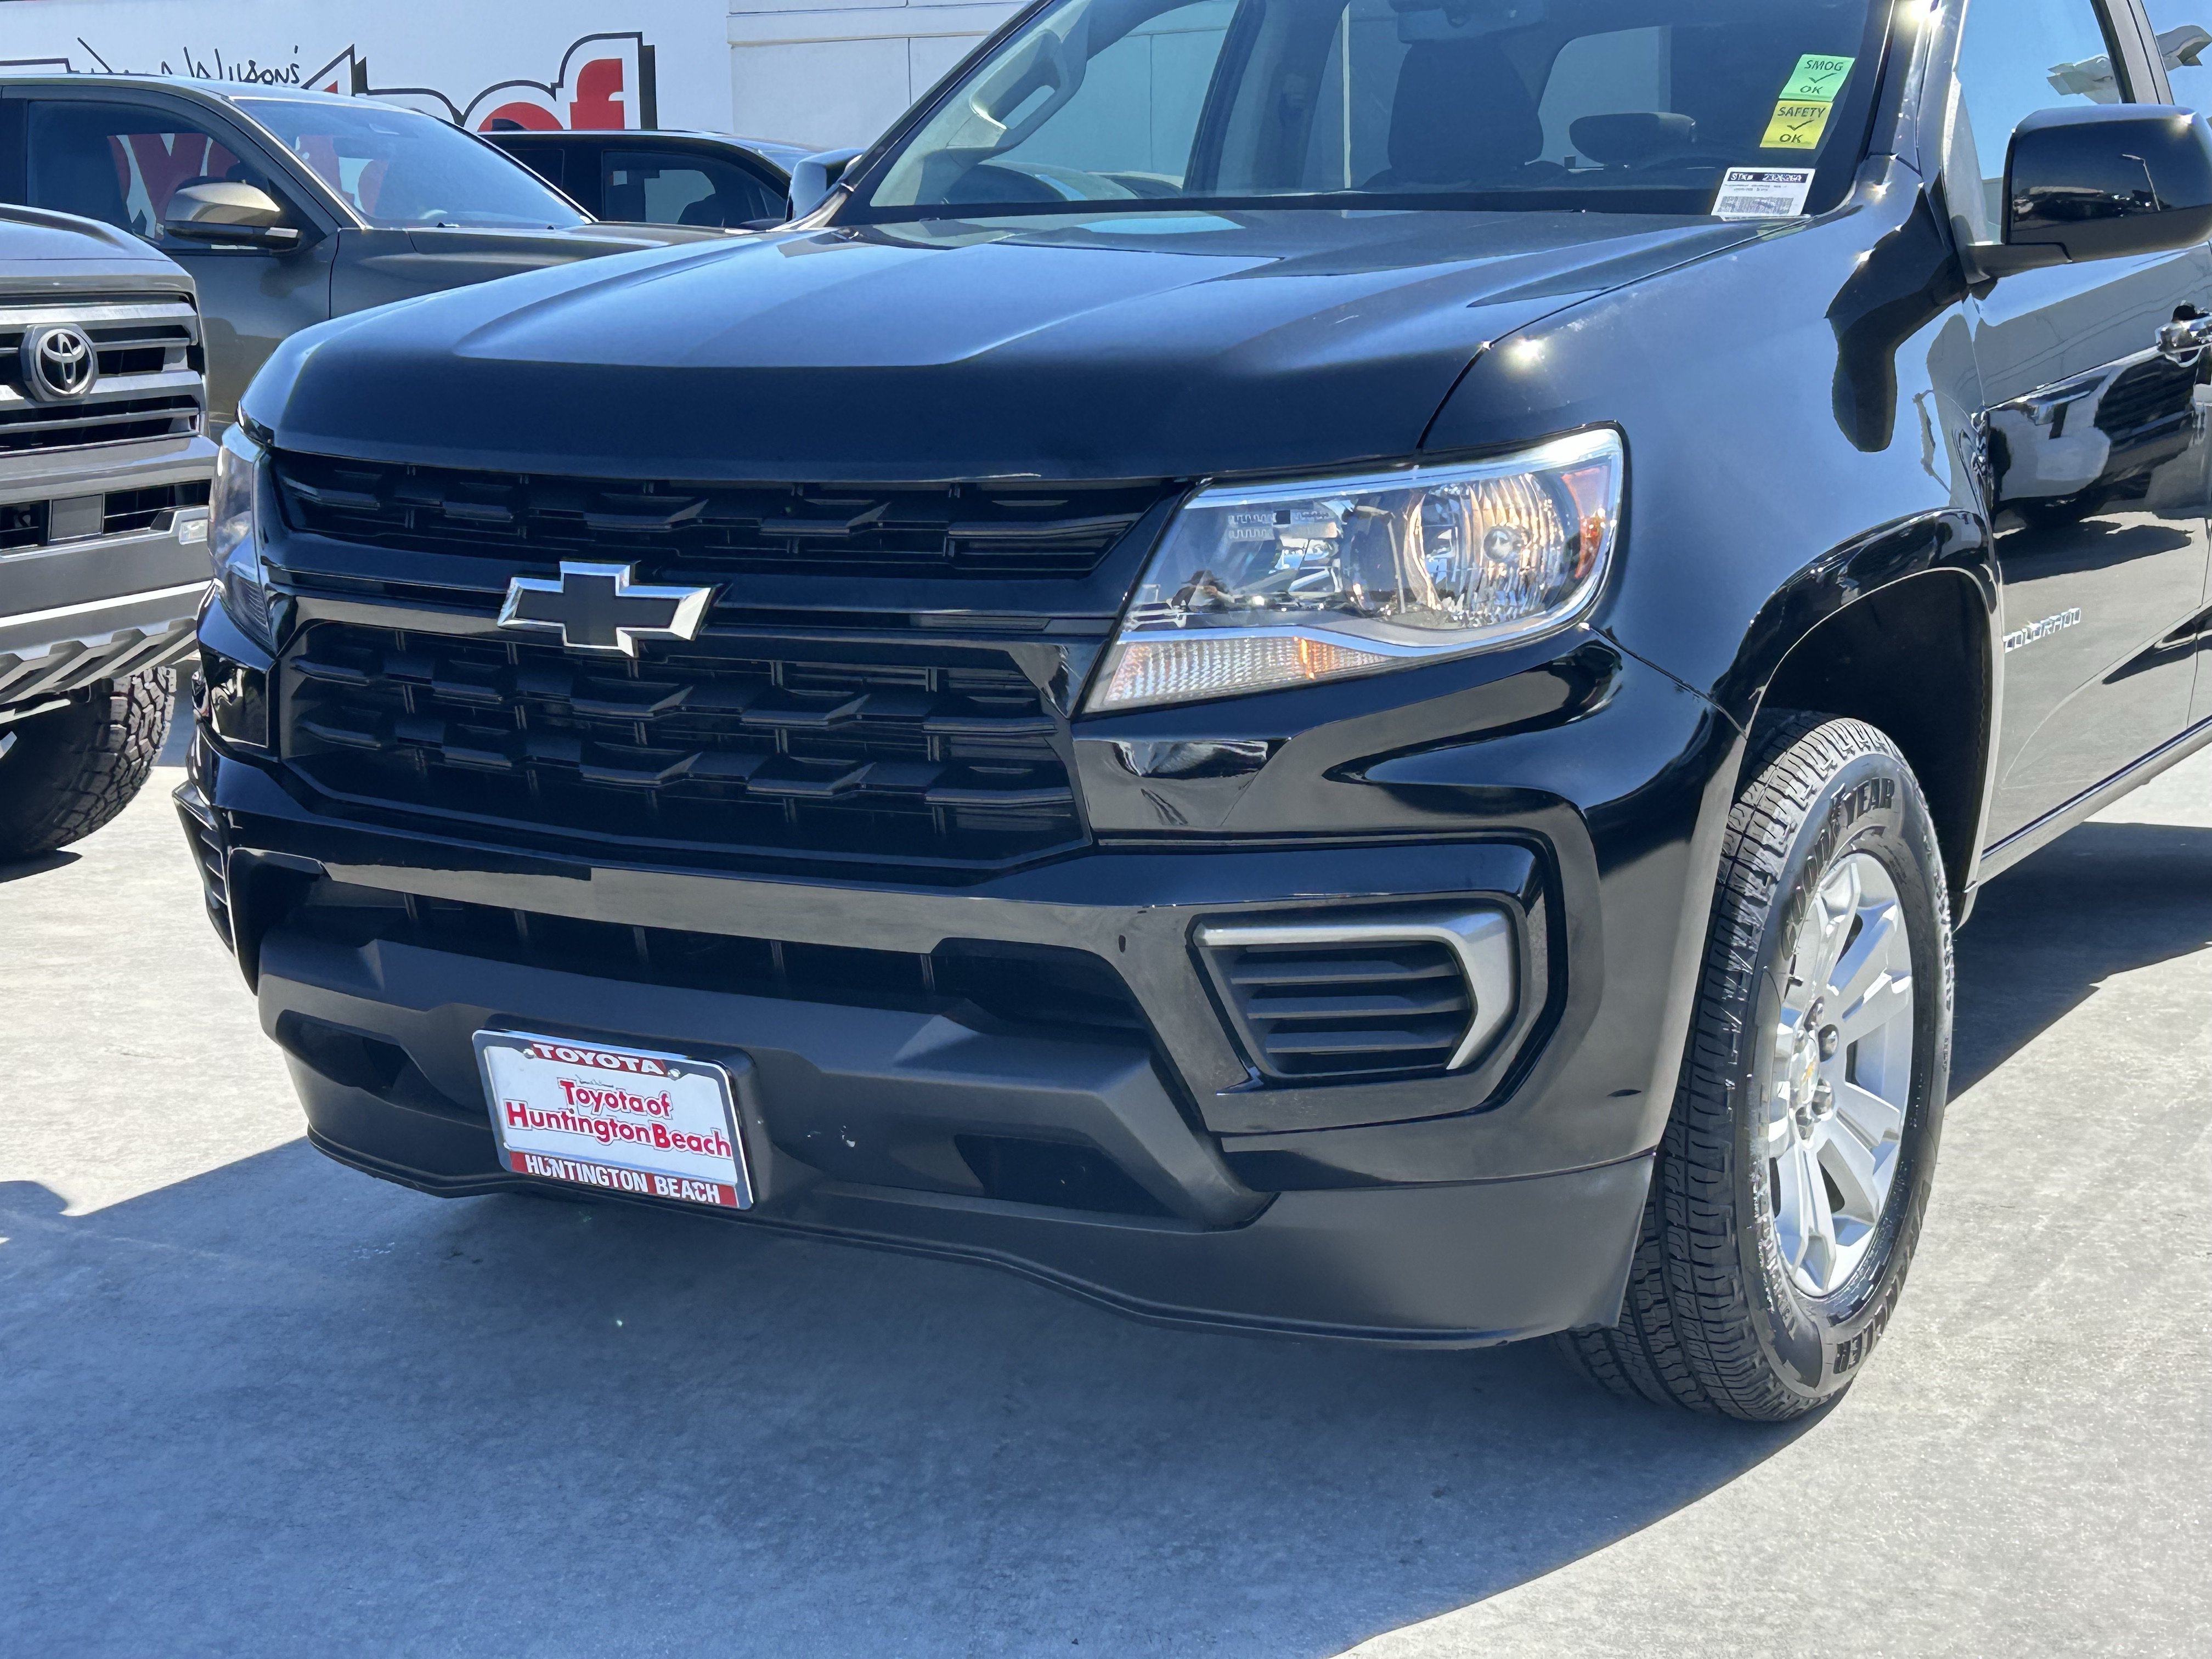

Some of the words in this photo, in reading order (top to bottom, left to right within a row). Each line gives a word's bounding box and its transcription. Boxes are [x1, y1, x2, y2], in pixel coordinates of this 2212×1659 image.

[1804, 60, 1844, 72] SMOG
[1800, 86, 1823, 94] OK
[1778, 106, 1826, 117] SAFETY
[1779, 134, 1804, 143] OK
[2002, 607, 2081, 653] COLORADO
[533, 1043, 665, 1076] TOYOTA
[560, 1080, 644, 1114] Toyota
[506, 1101, 651, 1143] Huntington
[652, 1122, 732, 1158] Beach
[525, 1154, 648, 1193] HUNTINGTON
[653, 1175, 721, 1204] BEACH
